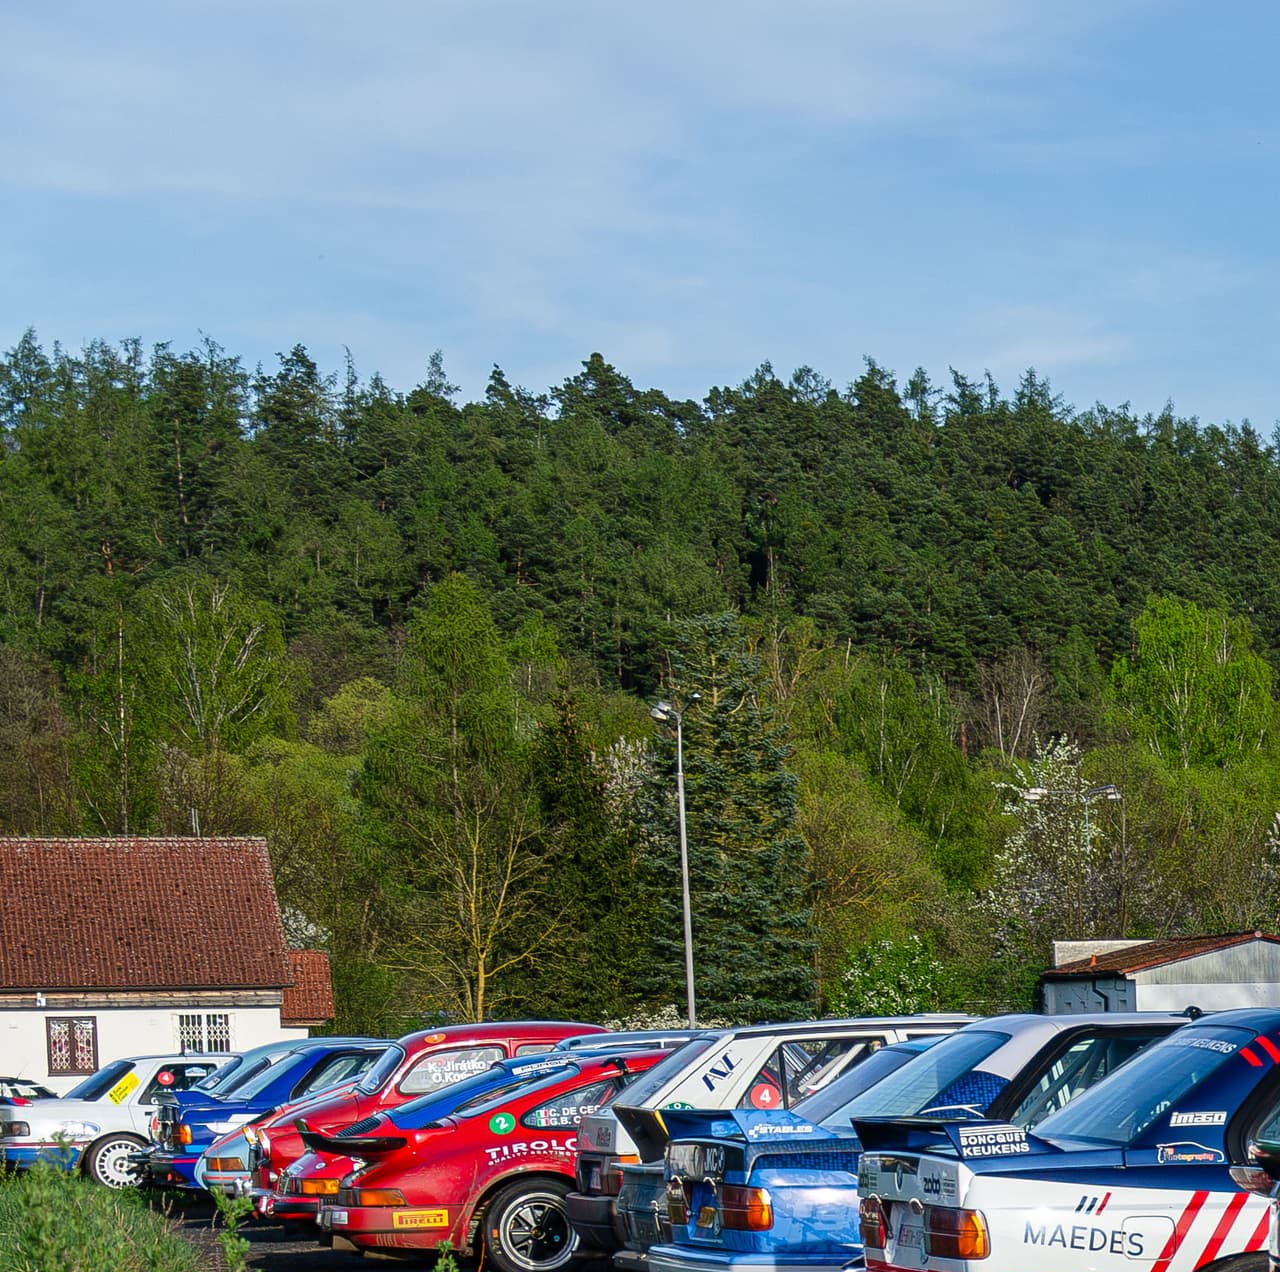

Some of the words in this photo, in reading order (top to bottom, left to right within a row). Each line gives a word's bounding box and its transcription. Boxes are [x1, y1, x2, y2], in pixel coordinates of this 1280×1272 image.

[163, 1073, 170, 1082] 4
[759, 1088, 772, 1104] 4
[562, 1106, 577, 1116] DE
[495, 1116, 509, 1130] 2
[960, 1132, 1026, 1146] BONCQUET
[962, 1142, 1030, 1157] KEUKENS
[398, 1213, 444, 1225] PIRELLI
[1023, 1219, 1145, 1257] MAEDES
